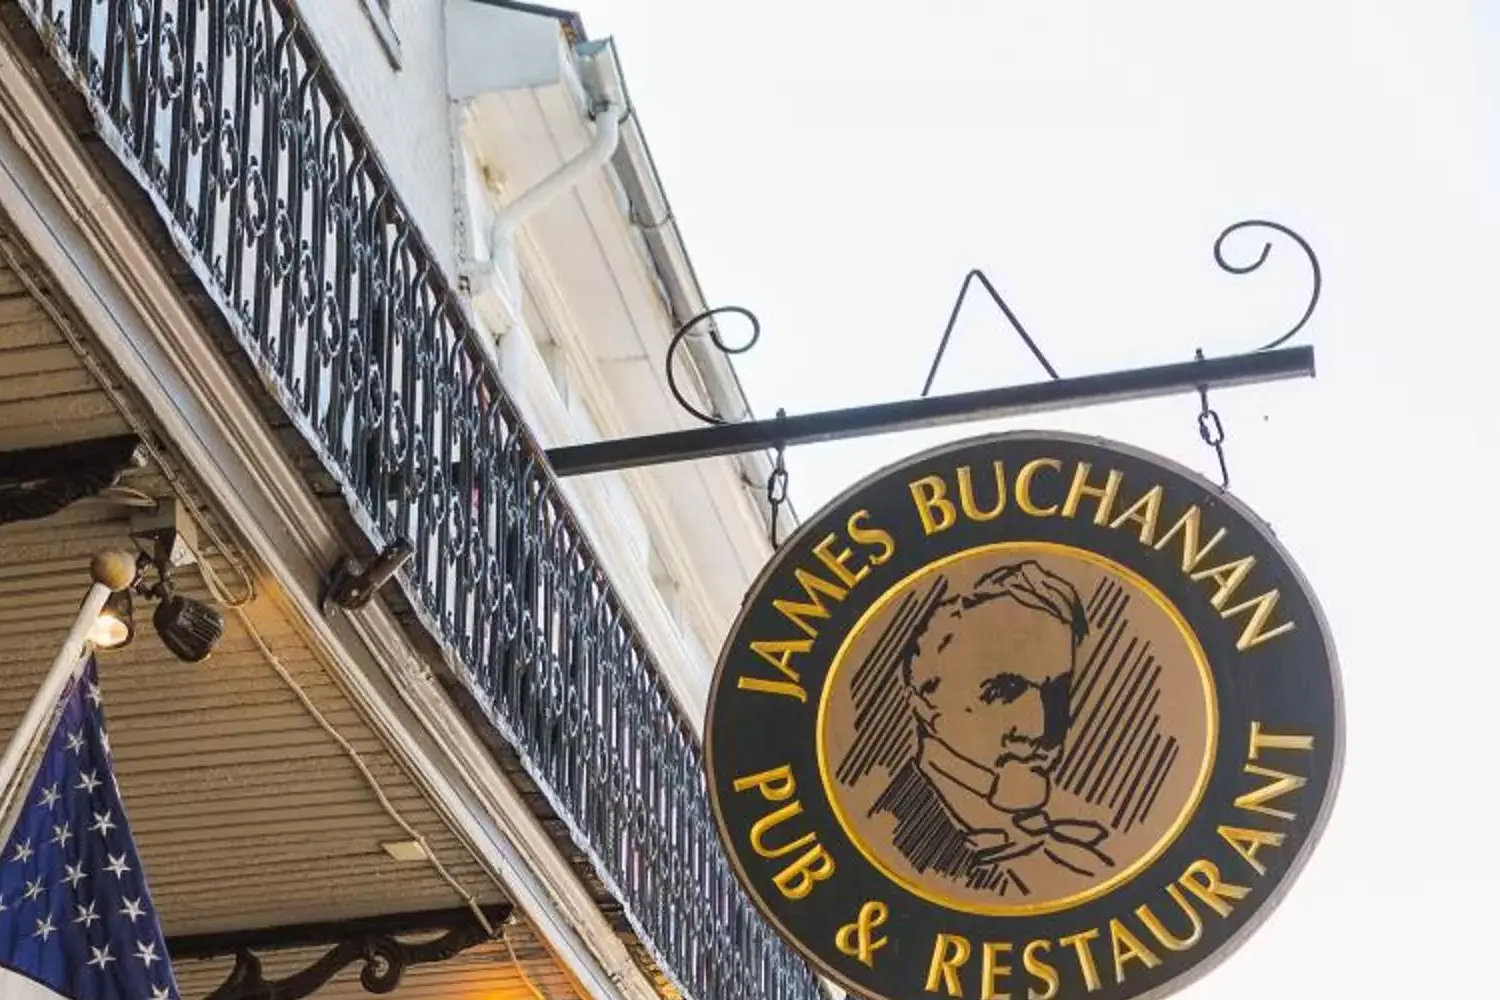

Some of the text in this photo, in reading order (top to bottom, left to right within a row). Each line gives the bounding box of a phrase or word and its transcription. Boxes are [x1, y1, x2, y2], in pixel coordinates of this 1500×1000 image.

[737, 457, 1296, 702] JAMES BUCHANAN
[732, 763, 837, 901] PUB
[835, 900, 890, 967] &
